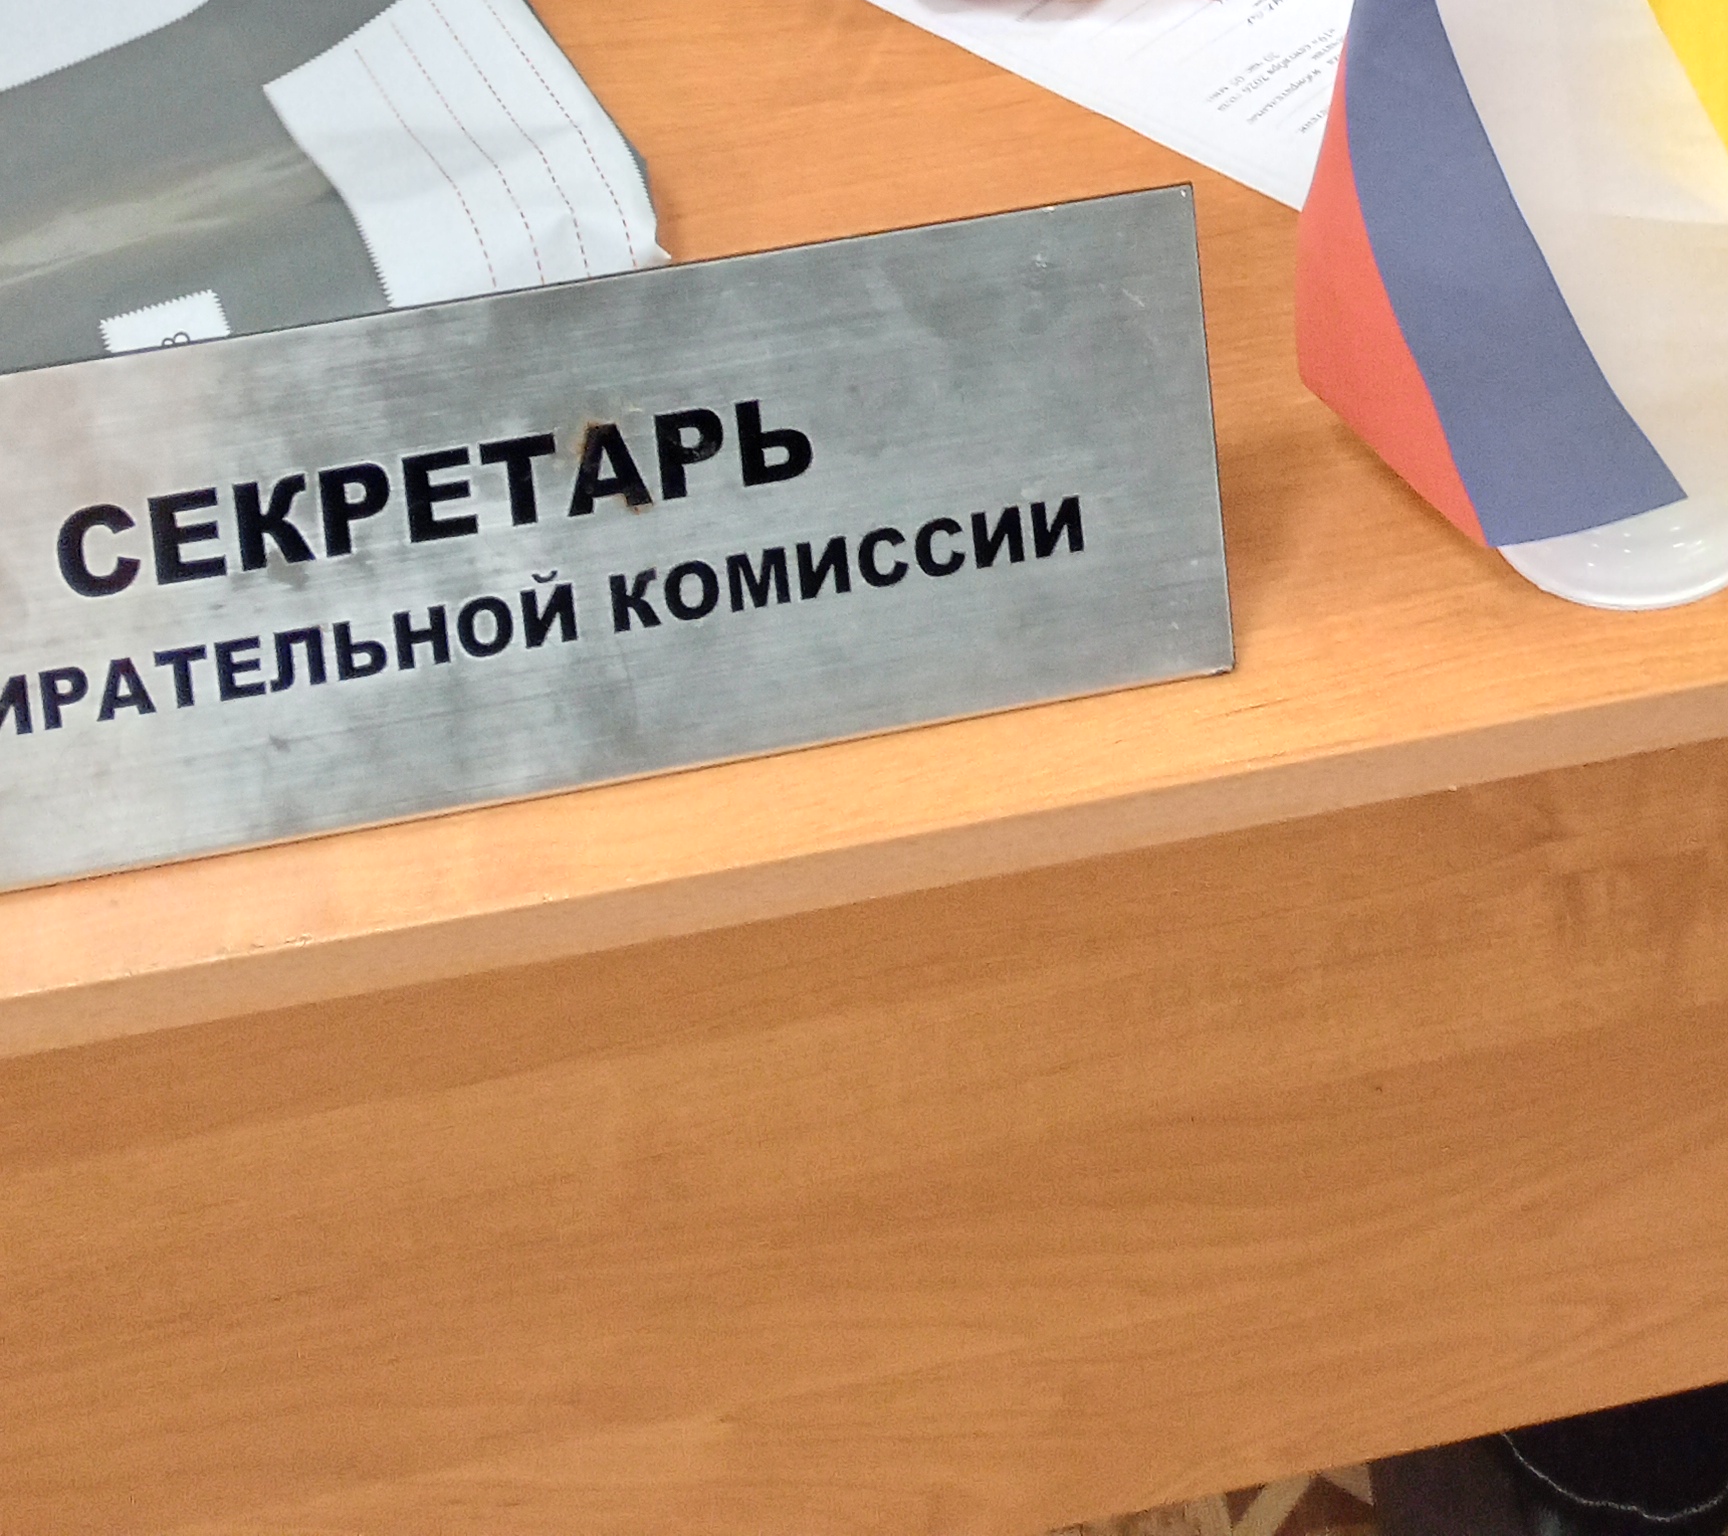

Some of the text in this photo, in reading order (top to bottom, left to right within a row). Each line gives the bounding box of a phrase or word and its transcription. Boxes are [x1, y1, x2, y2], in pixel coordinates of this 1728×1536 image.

[1309, 27, 1339, 45] «19»
[1263, 43, 1314, 76] сентября
[1238, 73, 1270, 93] 2026
[56, 399, 815, 599] СЕКРЕТАРЬ
[609, 496, 1088, 632] КОМИССИИ
